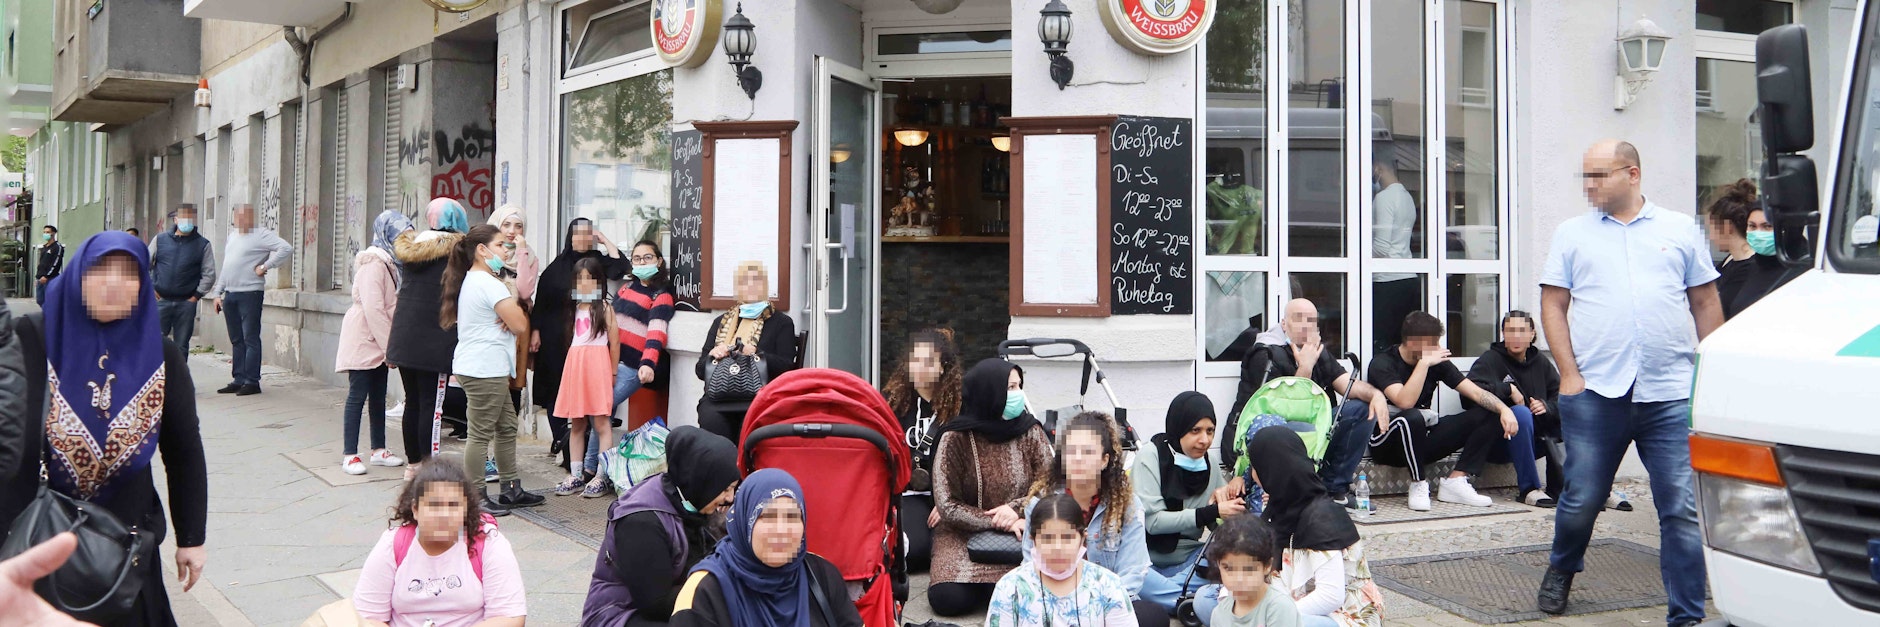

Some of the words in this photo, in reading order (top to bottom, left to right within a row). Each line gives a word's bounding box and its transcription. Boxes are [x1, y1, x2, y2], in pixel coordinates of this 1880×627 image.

[1111, 122, 1183, 158] Geöffnet
[1113, 222, 1130, 246] So
[1112, 250, 1162, 284] Montag
[1169, 262, 1187, 279] ist
[1112, 276, 1175, 313] Ruhetag
